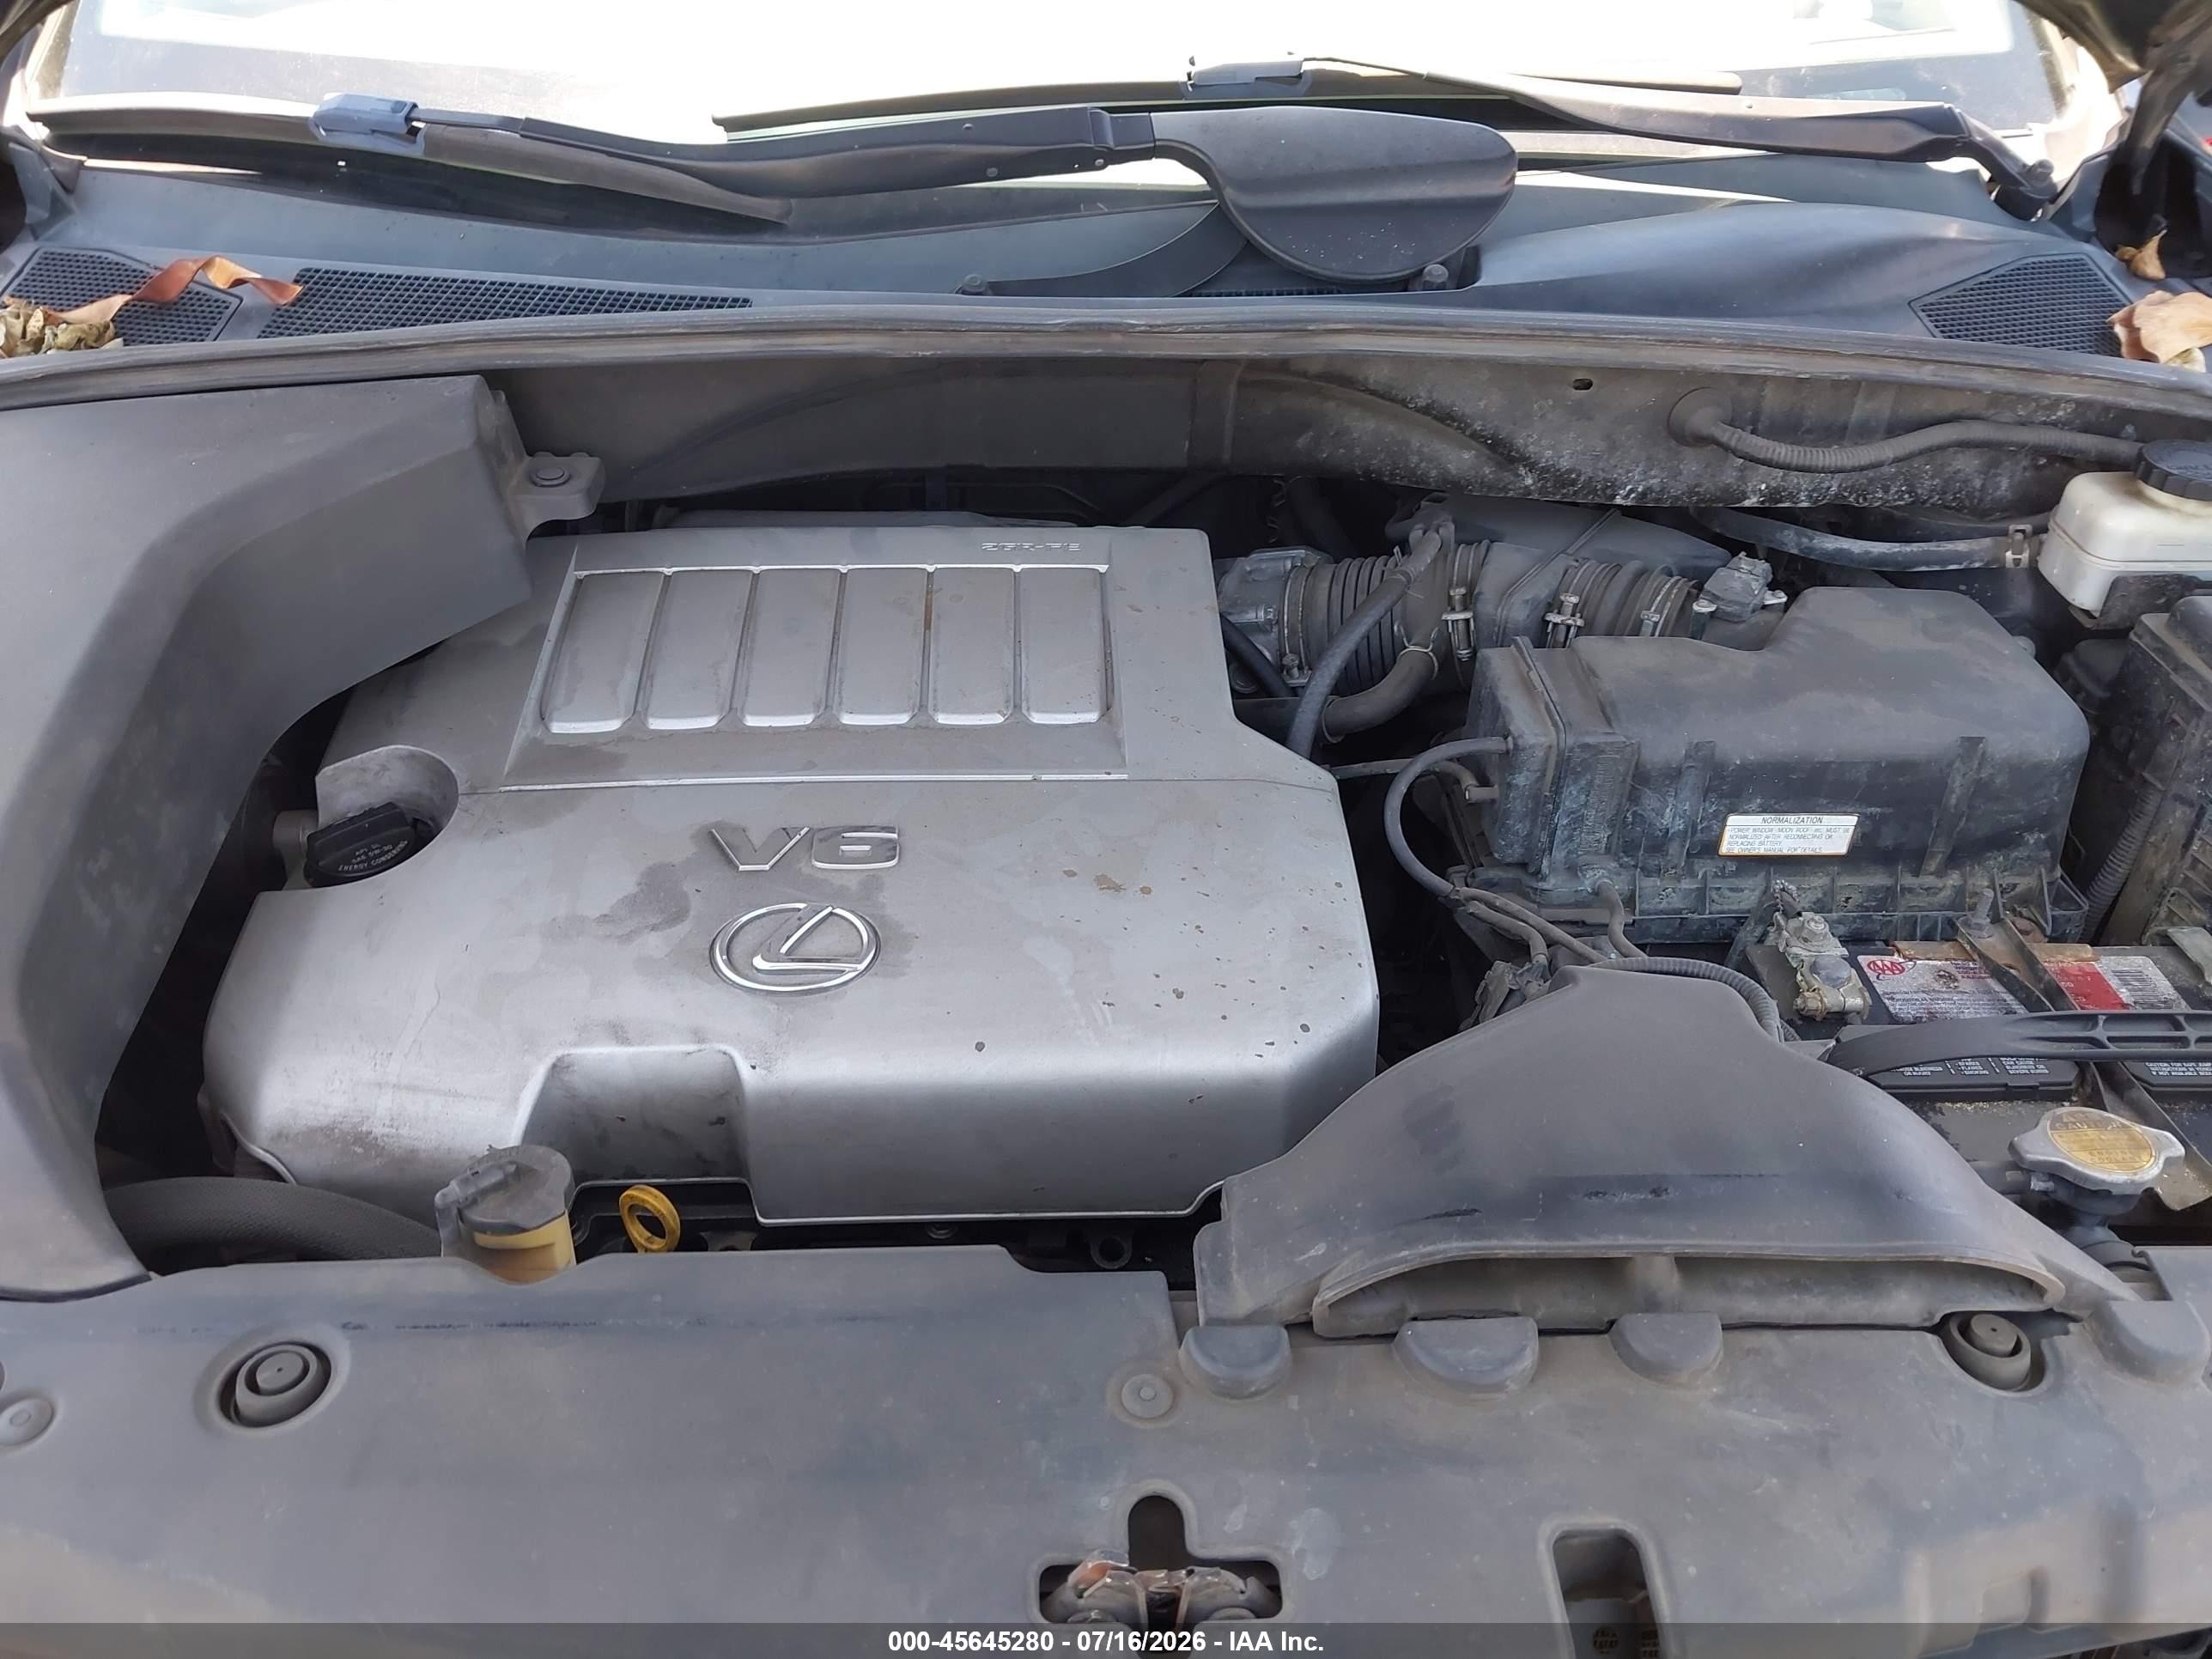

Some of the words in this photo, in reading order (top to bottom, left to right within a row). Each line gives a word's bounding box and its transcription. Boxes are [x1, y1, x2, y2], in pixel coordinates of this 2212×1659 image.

[711, 824, 900, 872] V6
[337, 862, 368, 872] ENERGY
[1870, 960, 1904, 975] AAA
